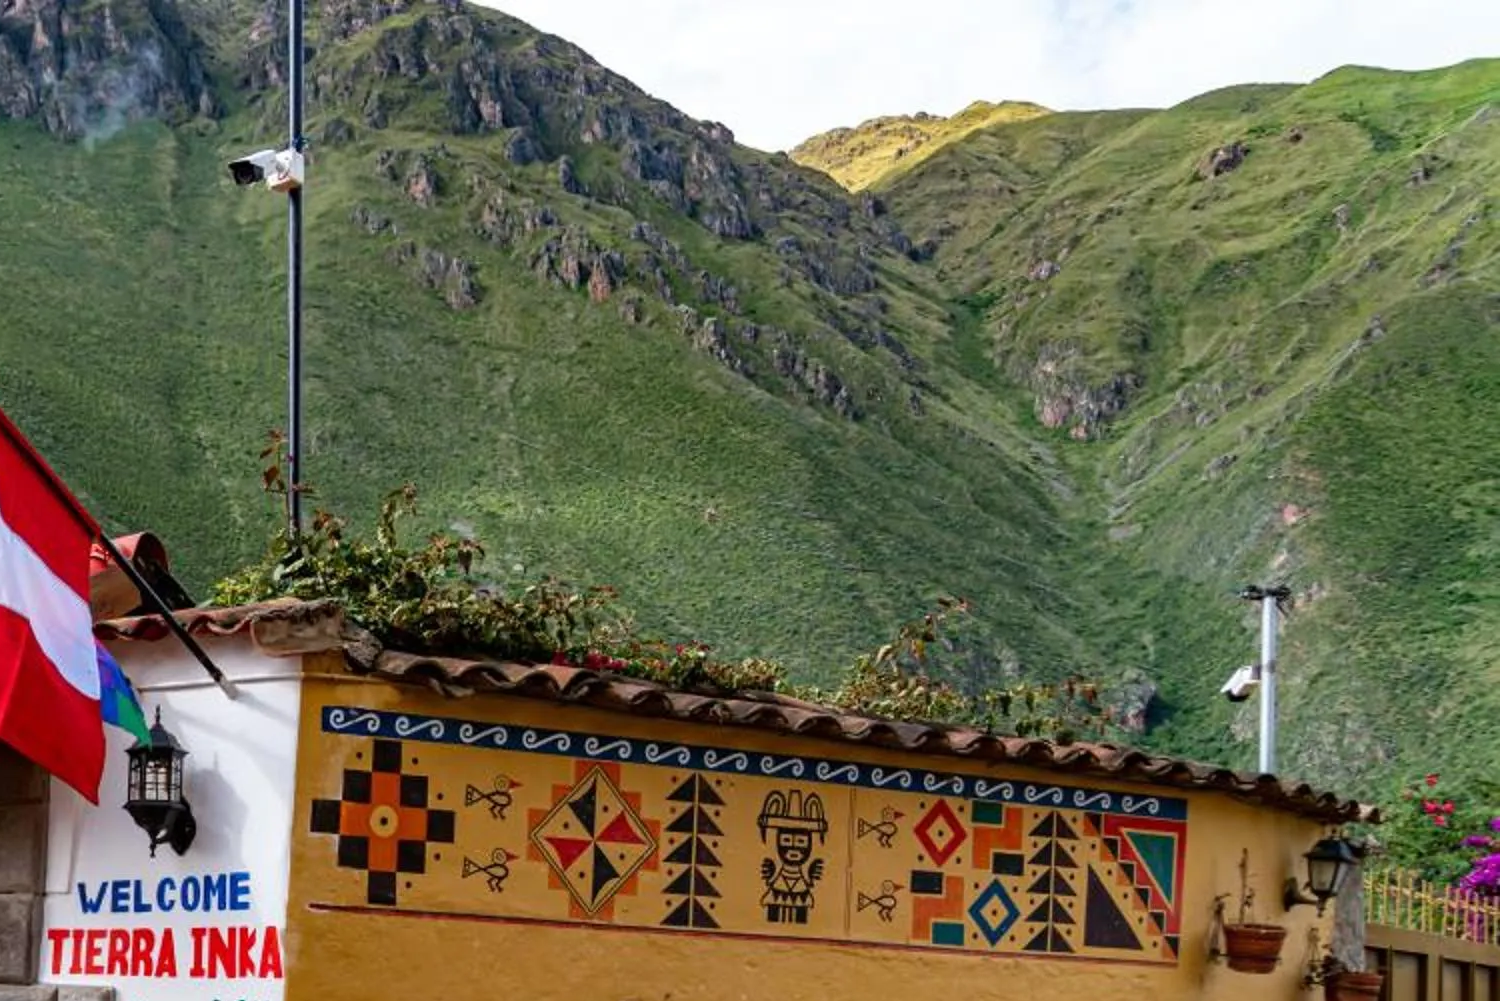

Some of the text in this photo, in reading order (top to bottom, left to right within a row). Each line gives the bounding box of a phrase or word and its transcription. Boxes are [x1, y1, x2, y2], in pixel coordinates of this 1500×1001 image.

[77, 872, 250, 913] WELCOME
[48, 926, 283, 979] TIERRA INKA
